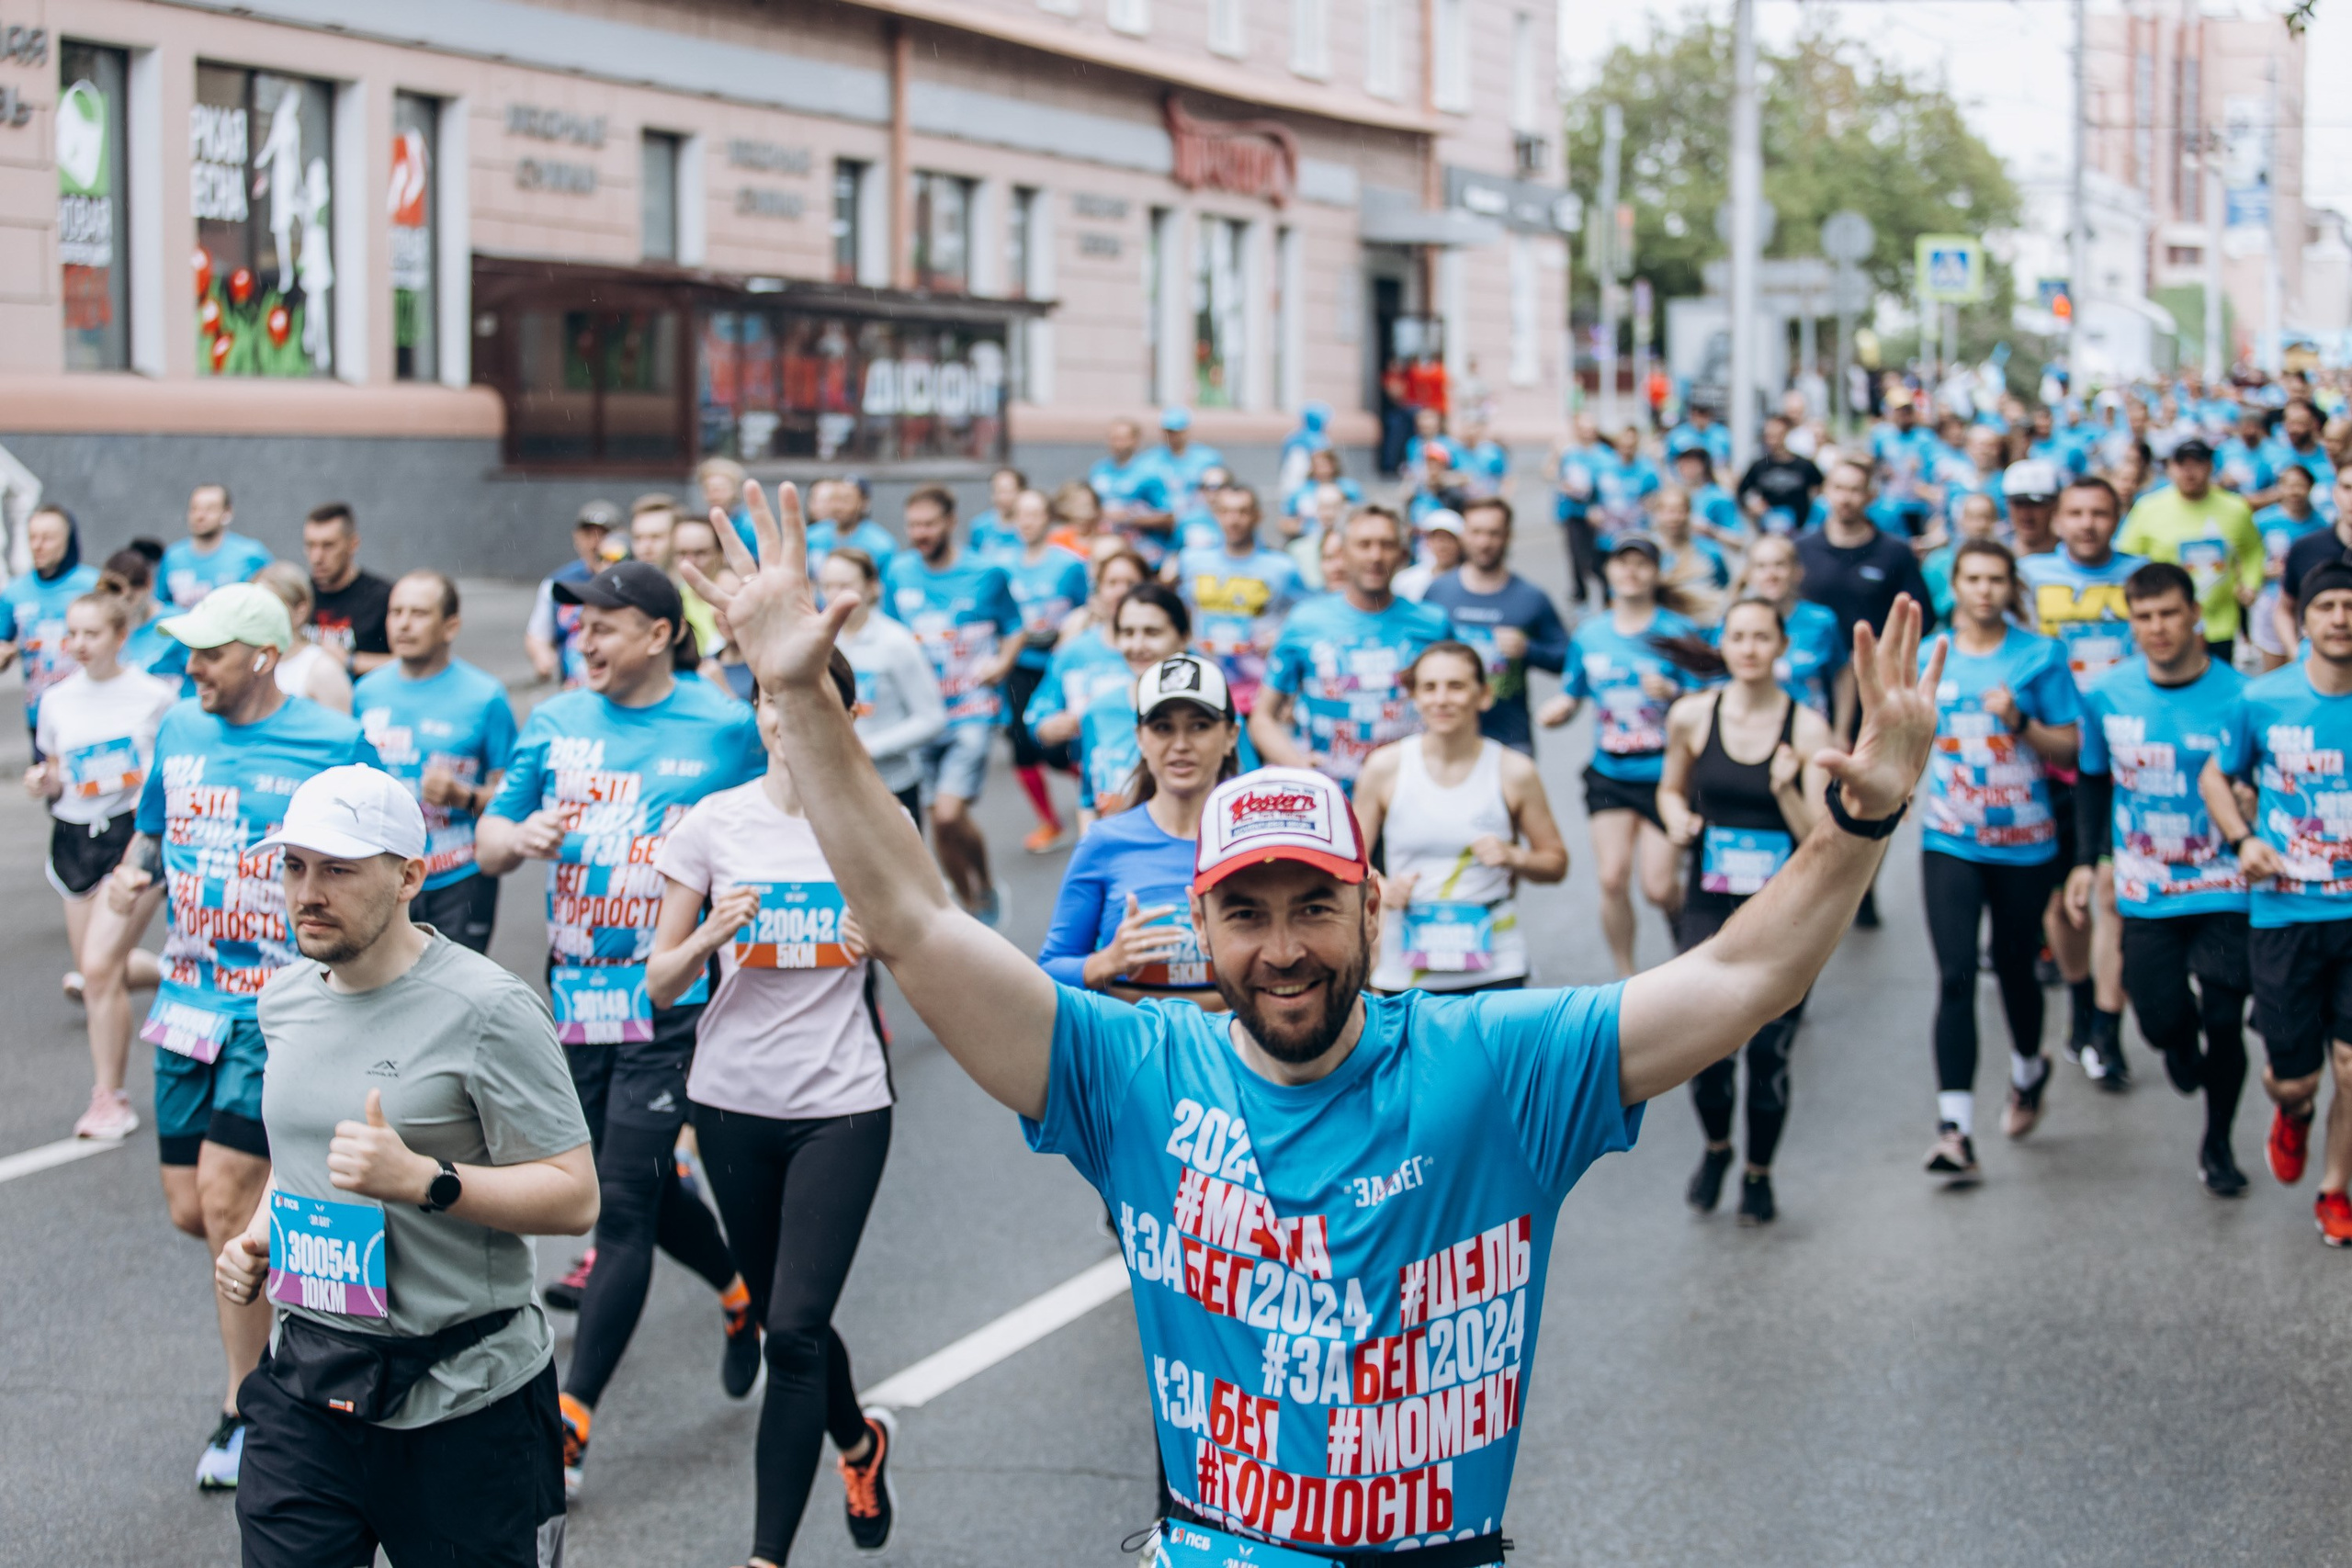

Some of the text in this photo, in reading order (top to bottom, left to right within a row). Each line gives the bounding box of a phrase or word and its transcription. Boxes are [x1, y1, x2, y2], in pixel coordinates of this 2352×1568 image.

[758, 907, 835, 942] 20042
[288, 1230, 360, 1283] 30054
[1121, 1201, 1373, 1341] #ЗАБЕГ2024
[1400, 1213, 1532, 1329] #ЦЕЛЬ
[1261, 1288, 1526, 1405] #ЗАБЕГ2024
[1154, 1354, 1280, 1465] #ЗАБЕГ
[1327, 1359, 1521, 1476] #МОМЕНТ
[1195, 1436, 1453, 1547] #ГОРДОСТЬ
